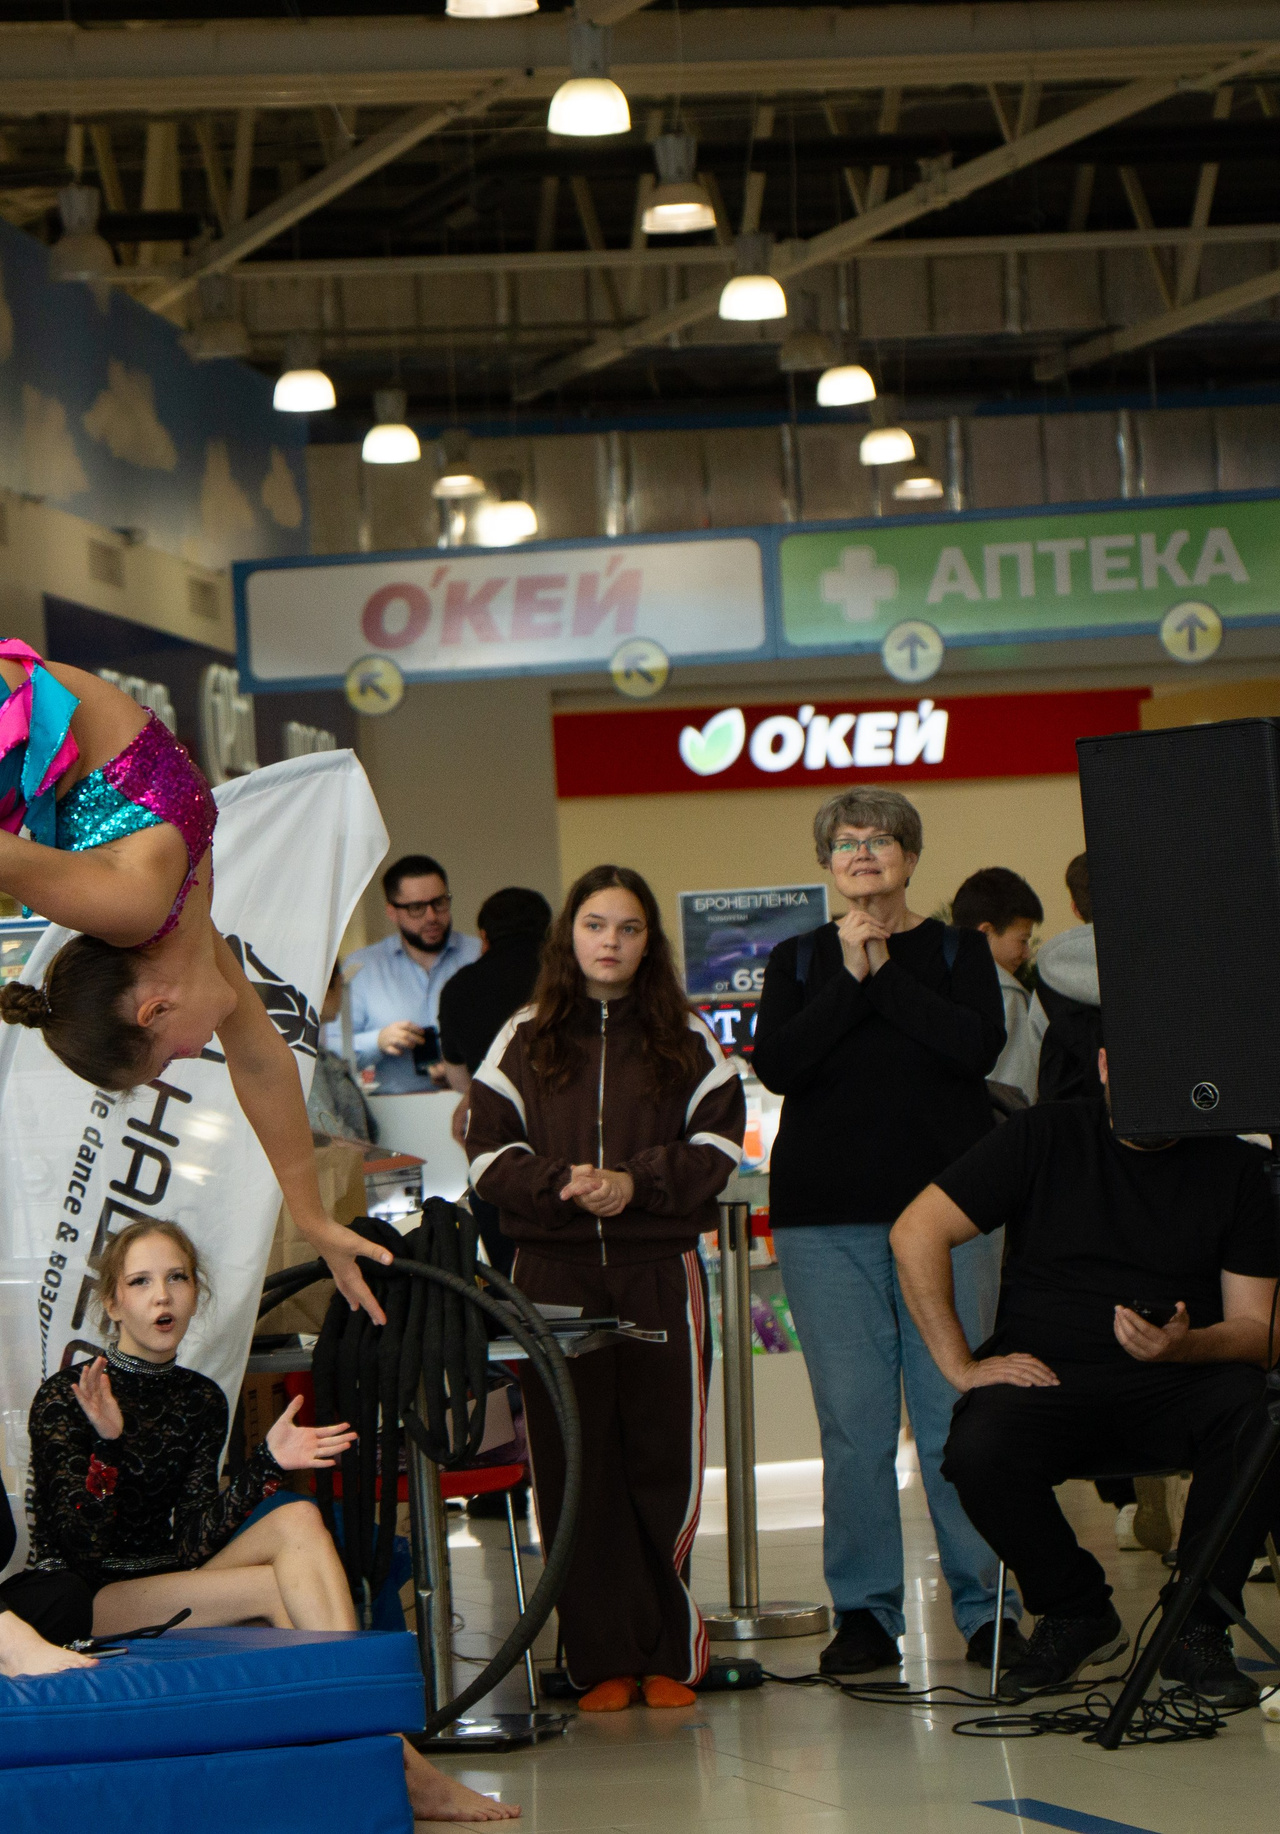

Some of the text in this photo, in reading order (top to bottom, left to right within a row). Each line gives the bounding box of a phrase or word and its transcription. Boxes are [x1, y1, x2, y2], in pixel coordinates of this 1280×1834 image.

[927, 526, 1251, 603] АПТЕКА
[694, 891, 810, 912] БРОНЕПЛЁНКА
[64, 1126, 104, 1216] dance
[56, 1221, 79, 1243] &
